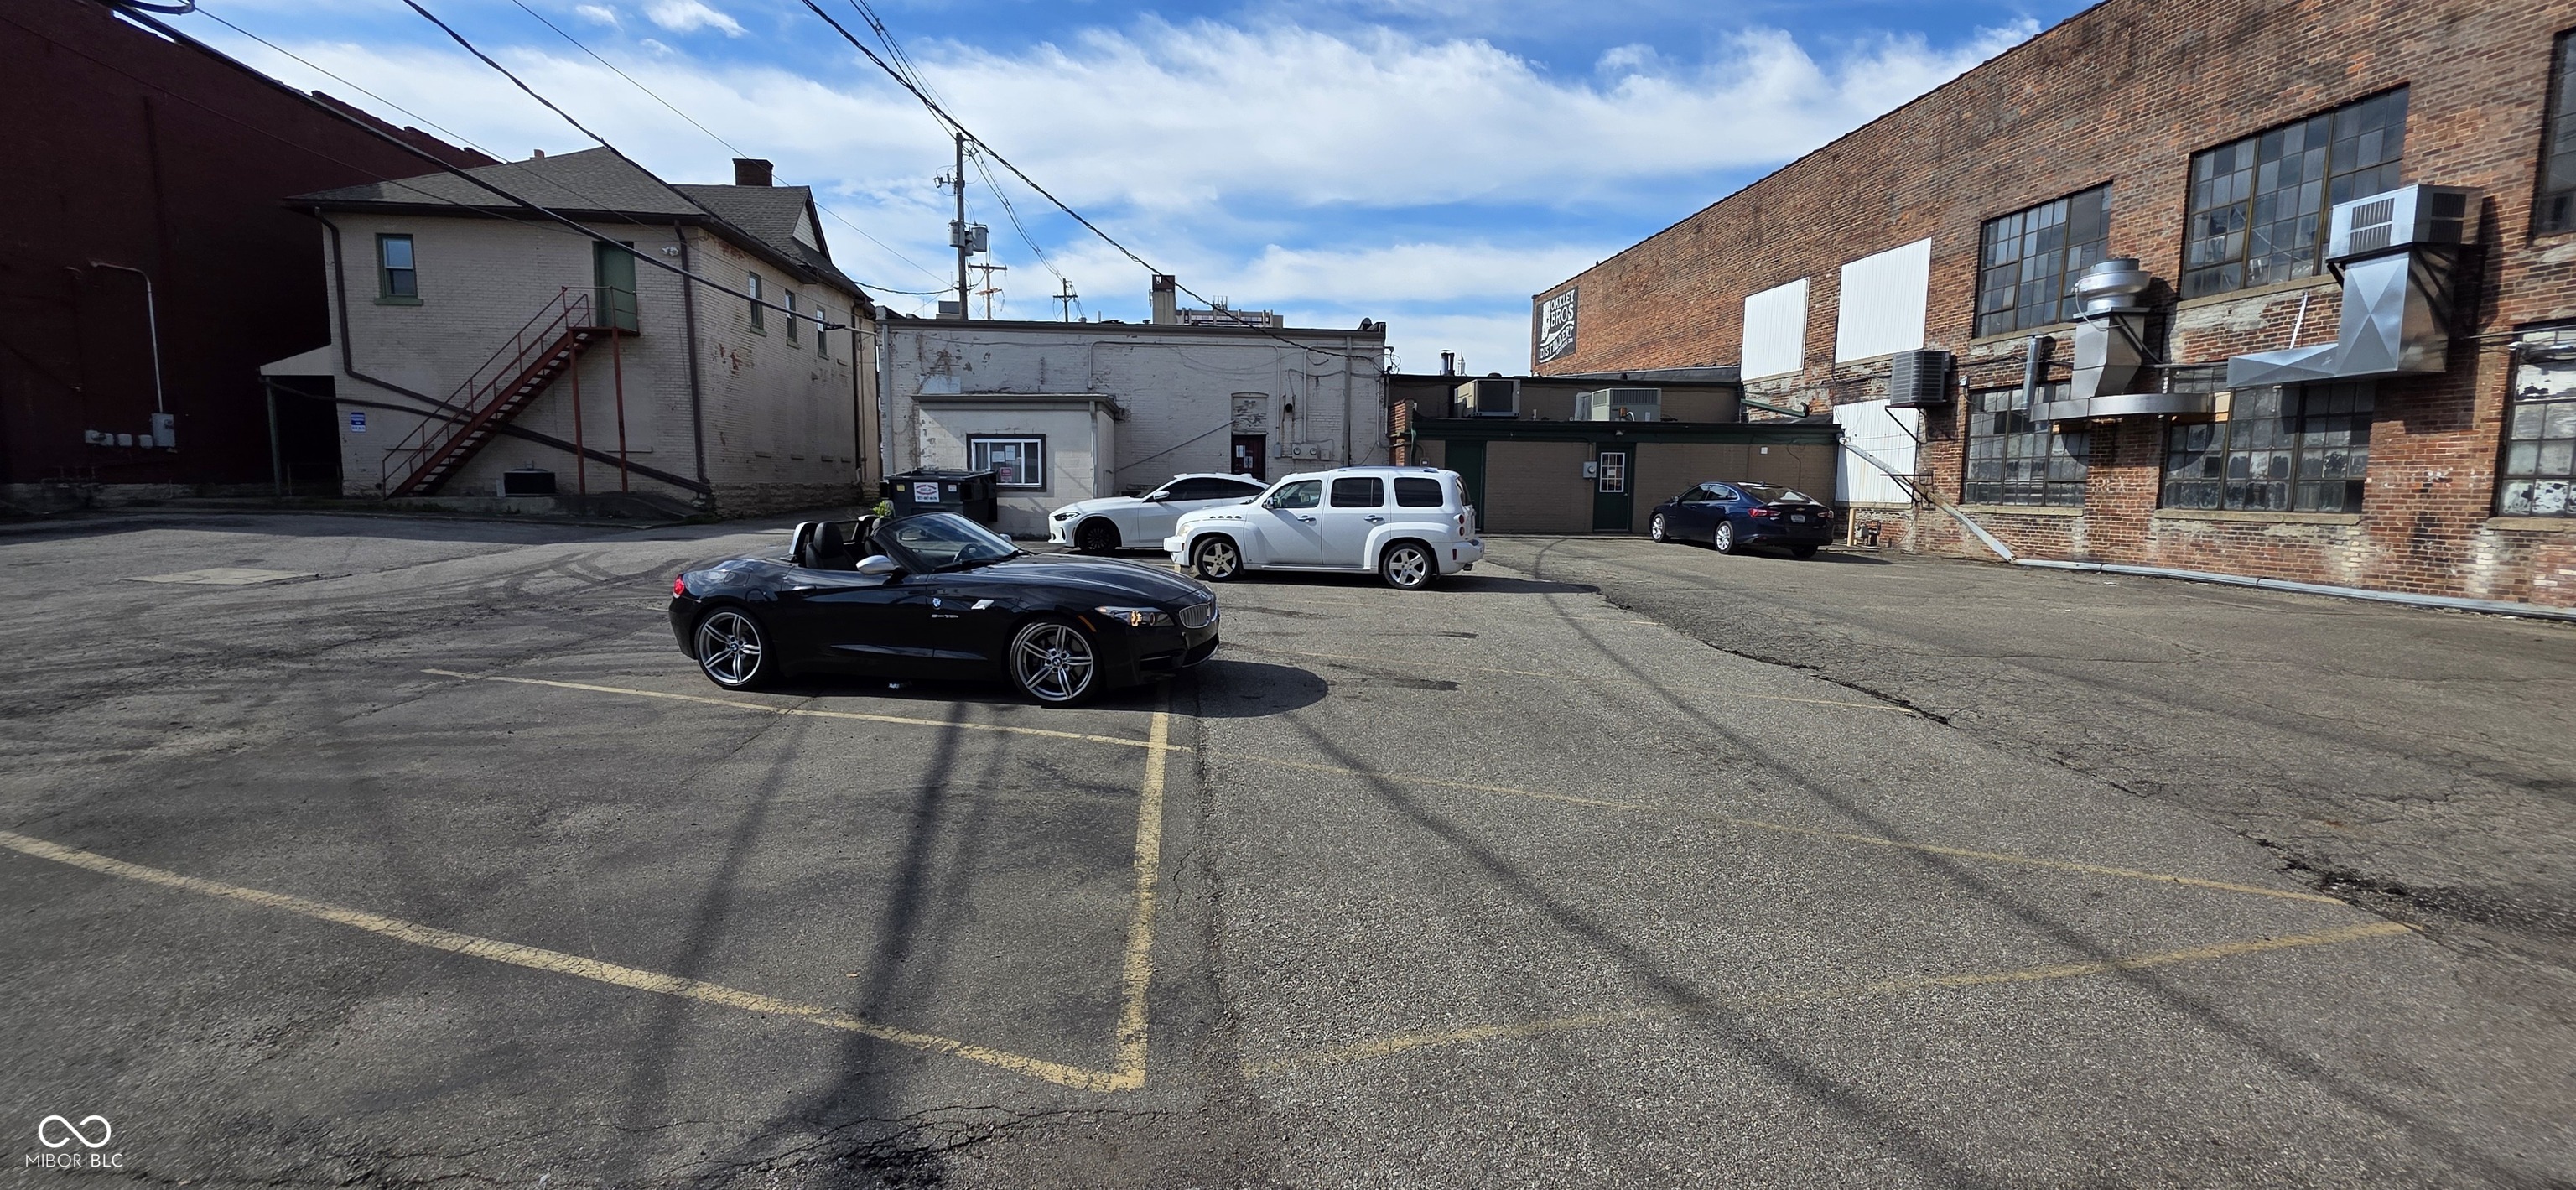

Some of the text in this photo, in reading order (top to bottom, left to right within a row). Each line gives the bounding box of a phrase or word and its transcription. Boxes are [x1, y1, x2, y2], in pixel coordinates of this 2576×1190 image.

[1550, 289, 1575, 311] OAKLEY
[1550, 304, 1574, 328] BROS
[1540, 325, 1574, 359] DISTILLERY
